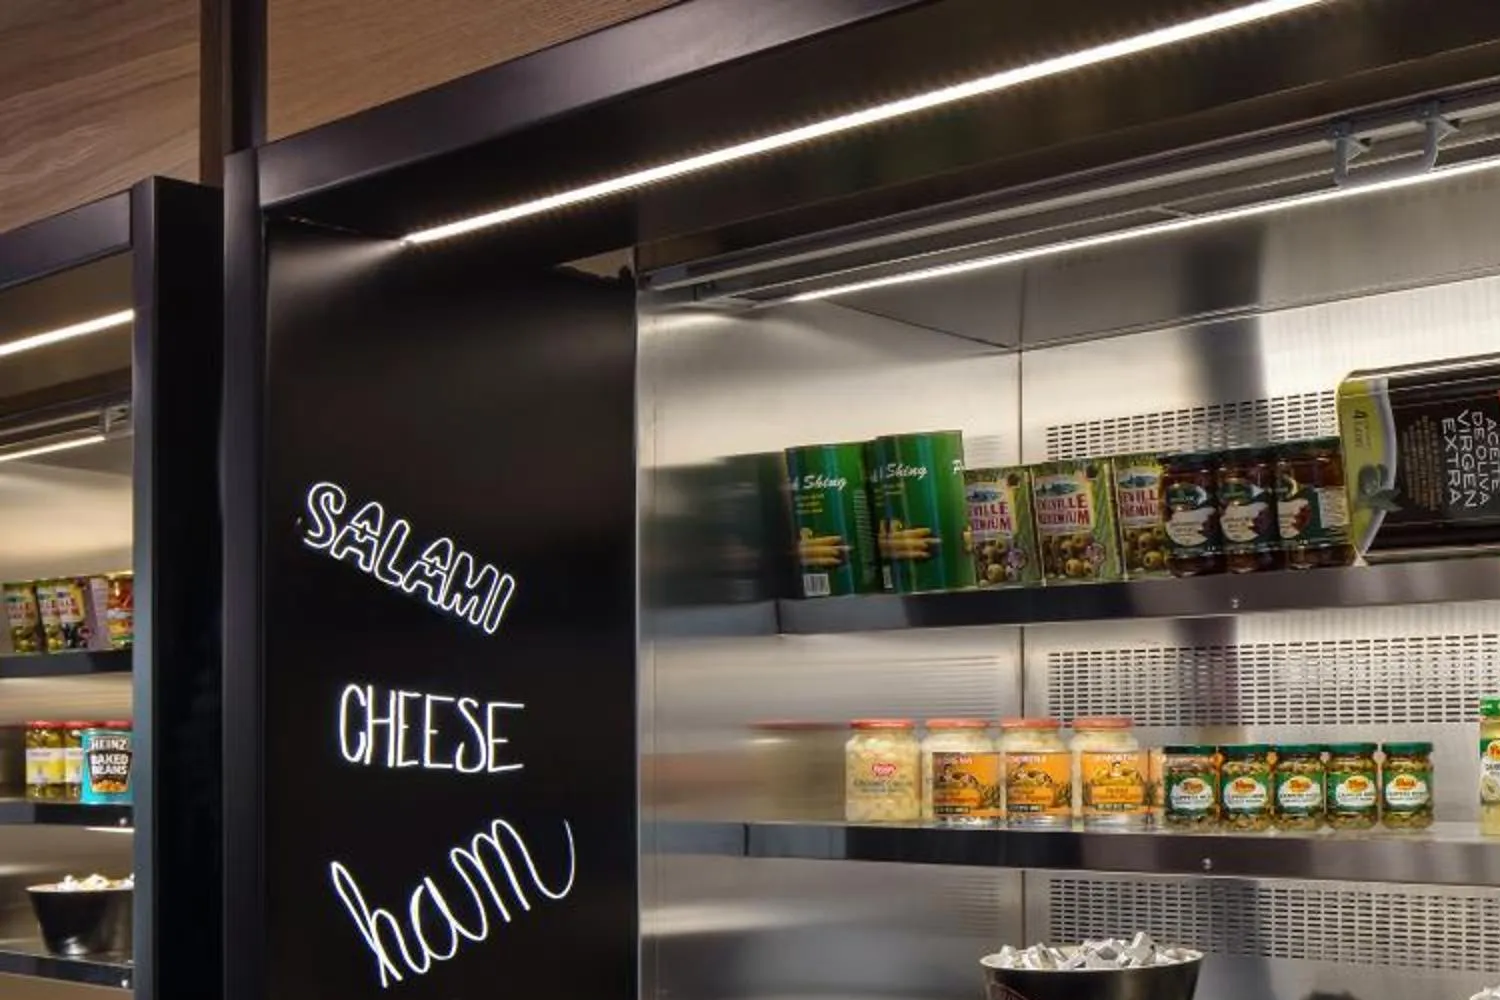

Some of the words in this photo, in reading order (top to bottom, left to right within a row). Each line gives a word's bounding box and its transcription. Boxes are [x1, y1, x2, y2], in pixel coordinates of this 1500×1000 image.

[1441, 417, 1462, 504] EXTRA
[1457, 409, 1477, 507] VIRGEN
[1472, 411, 1485, 440] DE
[1475, 445, 1491, 505] OLIVA
[304, 482, 515, 634] SALAMI
[339, 683, 524, 772] CHEESE
[330, 818, 576, 989] ham
